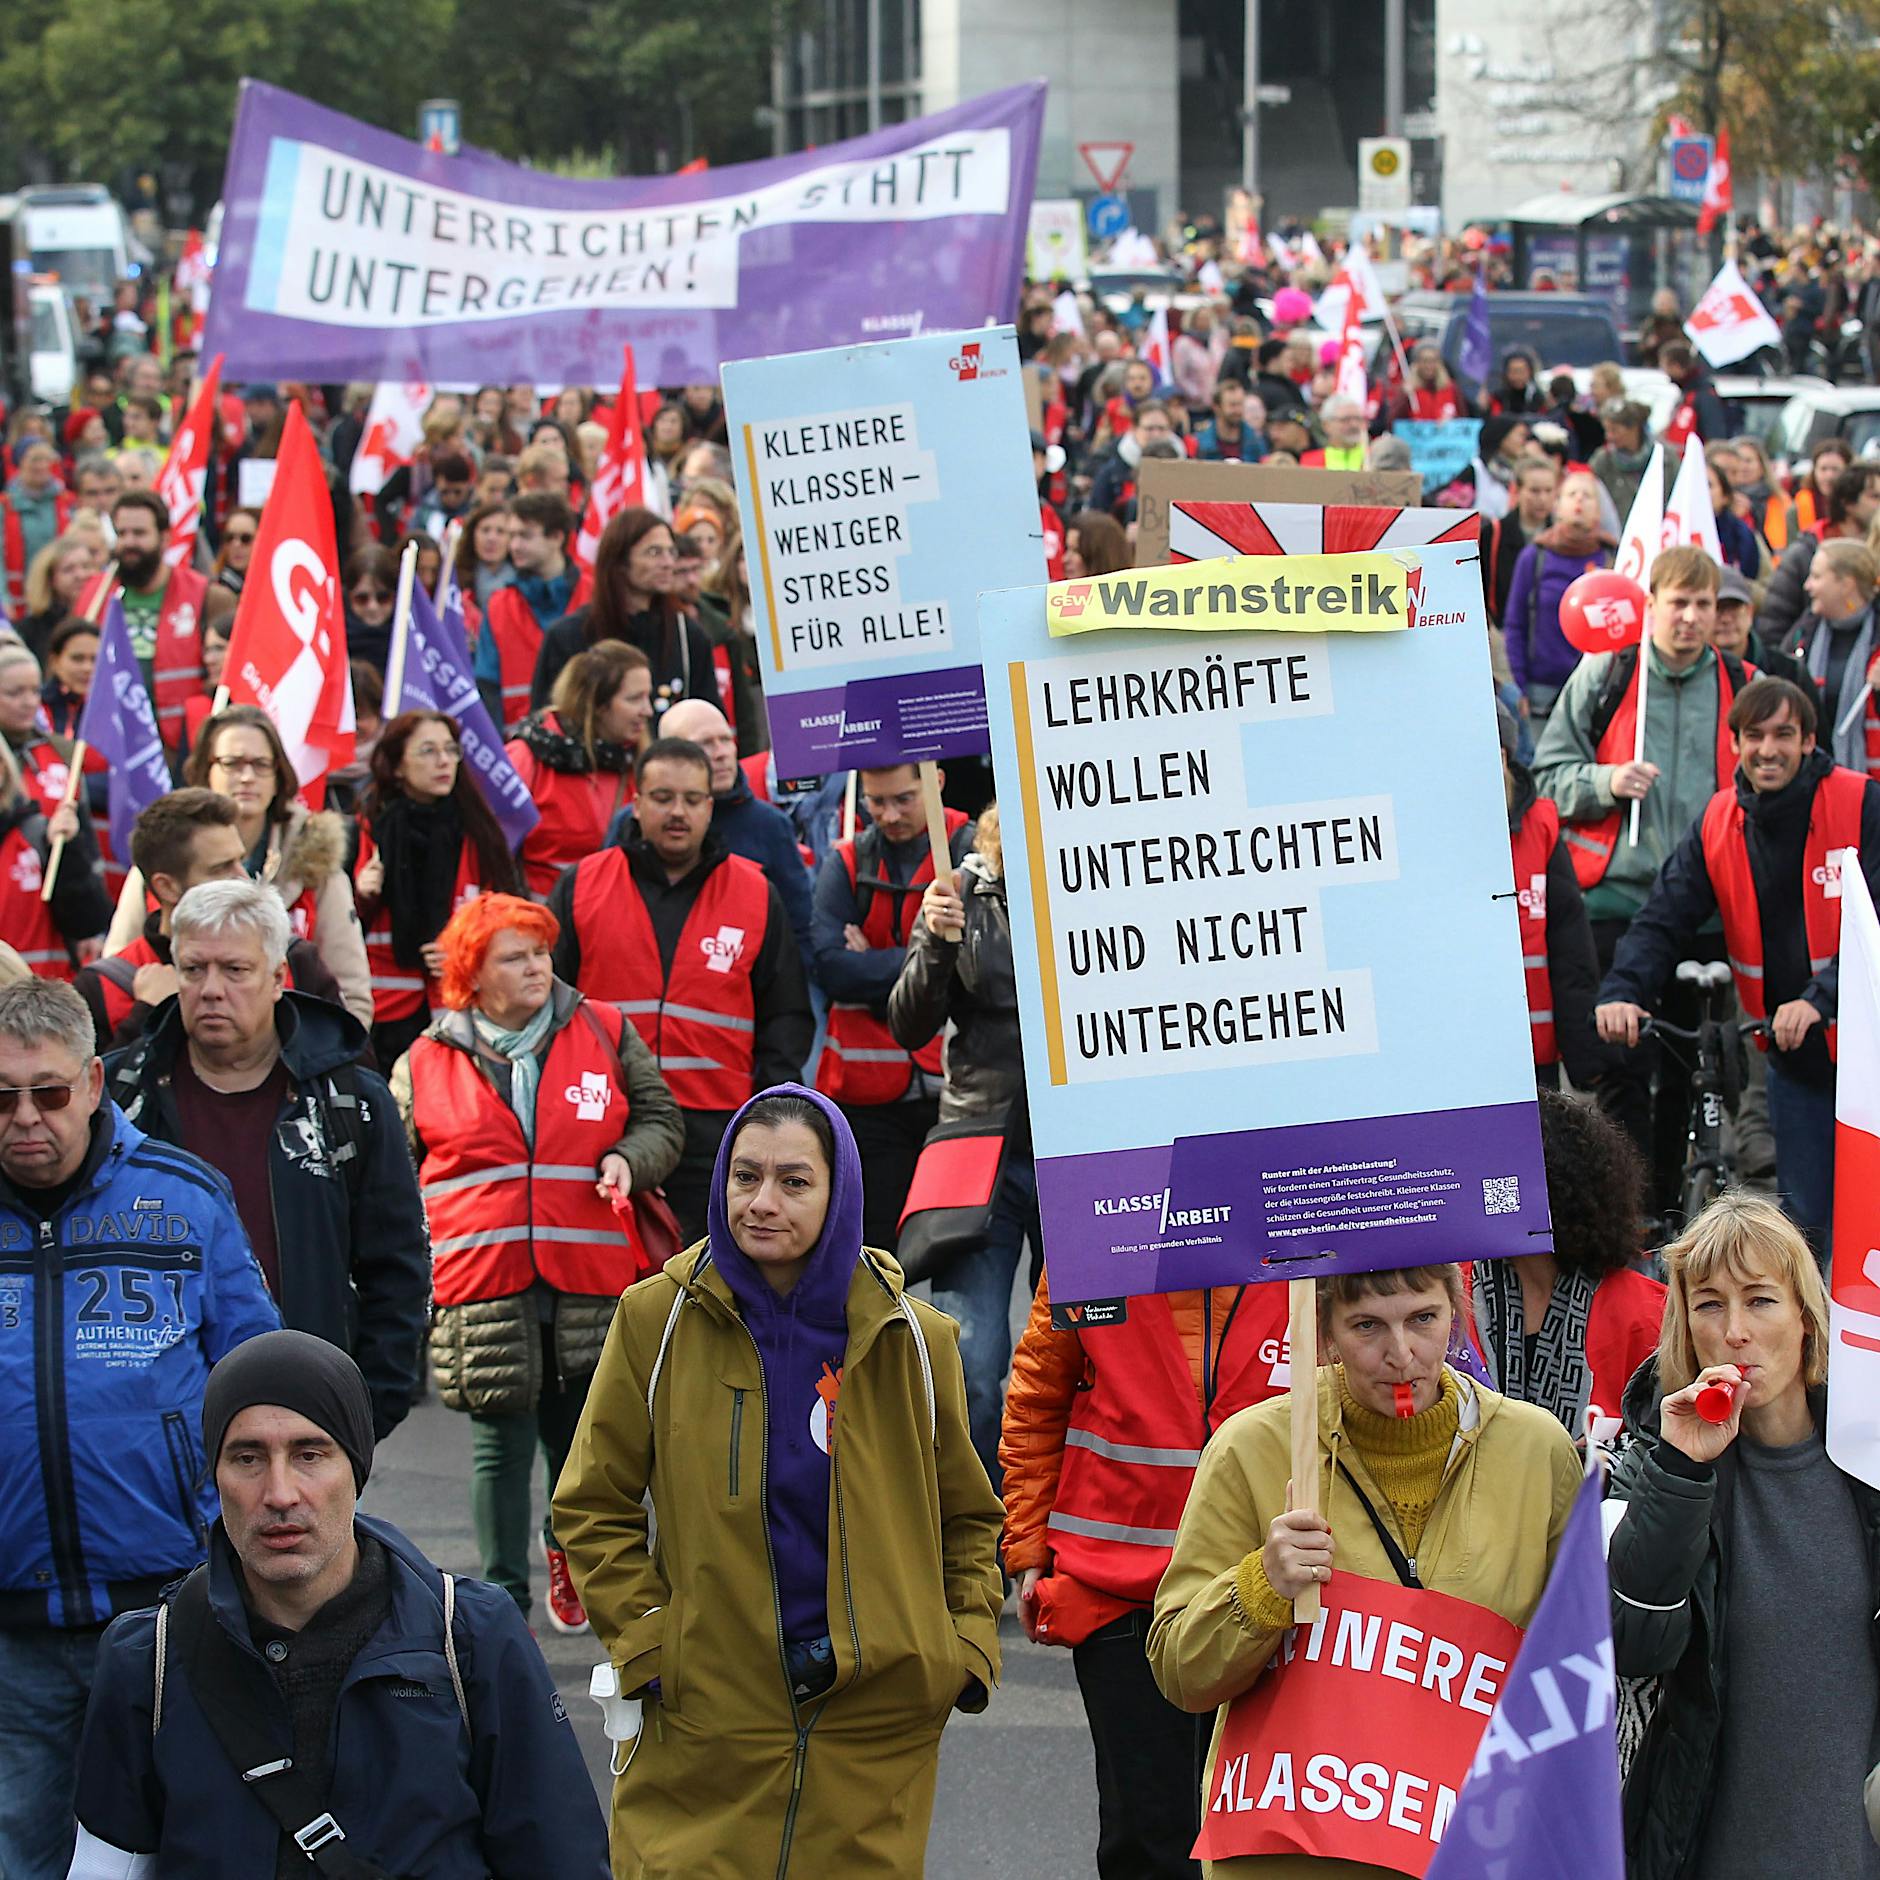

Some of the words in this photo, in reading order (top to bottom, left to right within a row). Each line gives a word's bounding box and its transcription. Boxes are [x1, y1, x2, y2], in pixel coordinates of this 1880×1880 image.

[321, 165, 758, 258] UNTERRICHTEN
[308, 249, 697, 316] UNTERGEHEN!
[764, 414, 906, 459] KLEINERE
[774, 515, 902, 556] WENIGER
[783, 566, 890, 604] STRESS
[1098, 574, 1399, 617] Warnstreik
[791, 618, 843, 652] FÜR
[862, 607, 946, 643] ALLE!
[1419, 611, 1465, 627] BERLIN
[1043, 653, 1311, 728] LEHRKRÄFTE
[457, 717, 532, 809] RBEIT
[1046, 749, 1211, 811] WOLLEN
[1059, 815, 1383, 893] UNTERRICHTEN
[699, 936, 744, 961] GEW
[1068, 924, 1145, 976] UND
[1176, 906, 1308, 965] NICHT
[1076, 987, 1346, 1059] UNTERGEHEN
[564, 1085, 612, 1107] GEW
[1262, 1171, 1291, 1180] Runter
[1291, 1168, 1307, 1177] mit
[1307, 1167, 1322, 1175] der
[1323, 1158, 1397, 1174] Arbeitsbelastung!
[1262, 1185, 1277, 1194] Wir
[1278, 1183, 1307, 1193] fordern
[1308, 1180, 1331, 1190] einen
[1331, 1175, 1377, 1187] Tarifvertrag
[1378, 1168, 1455, 1182] Gesundheitsschutz,
[1264, 1200, 1278, 1209] der
[1279, 1198, 1292, 1208] die
[1293, 1193, 1346, 1206] Klassengröße
[1396, 1185, 1430, 1195] Kleinere
[1430, 1182, 1461, 1192] Klassen
[1266, 1213, 1302, 1223] schützen
[1302, 1210, 1316, 1220] die
[1316, 1206, 1361, 1218] Gesundheit
[1362, 1203, 1392, 1214] unserer
[71, 1212, 190, 1244] DAVID
[1167, 1206, 1232, 1227] ARBEIT
[1111, 1243, 1138, 1253] Bildung
[1138, 1242, 1149, 1251] im
[1149, 1239, 1185, 1251] gesunden
[1185, 1235, 1222, 1246] Verhältnis
[1258, 1338, 1291, 1364] GE
